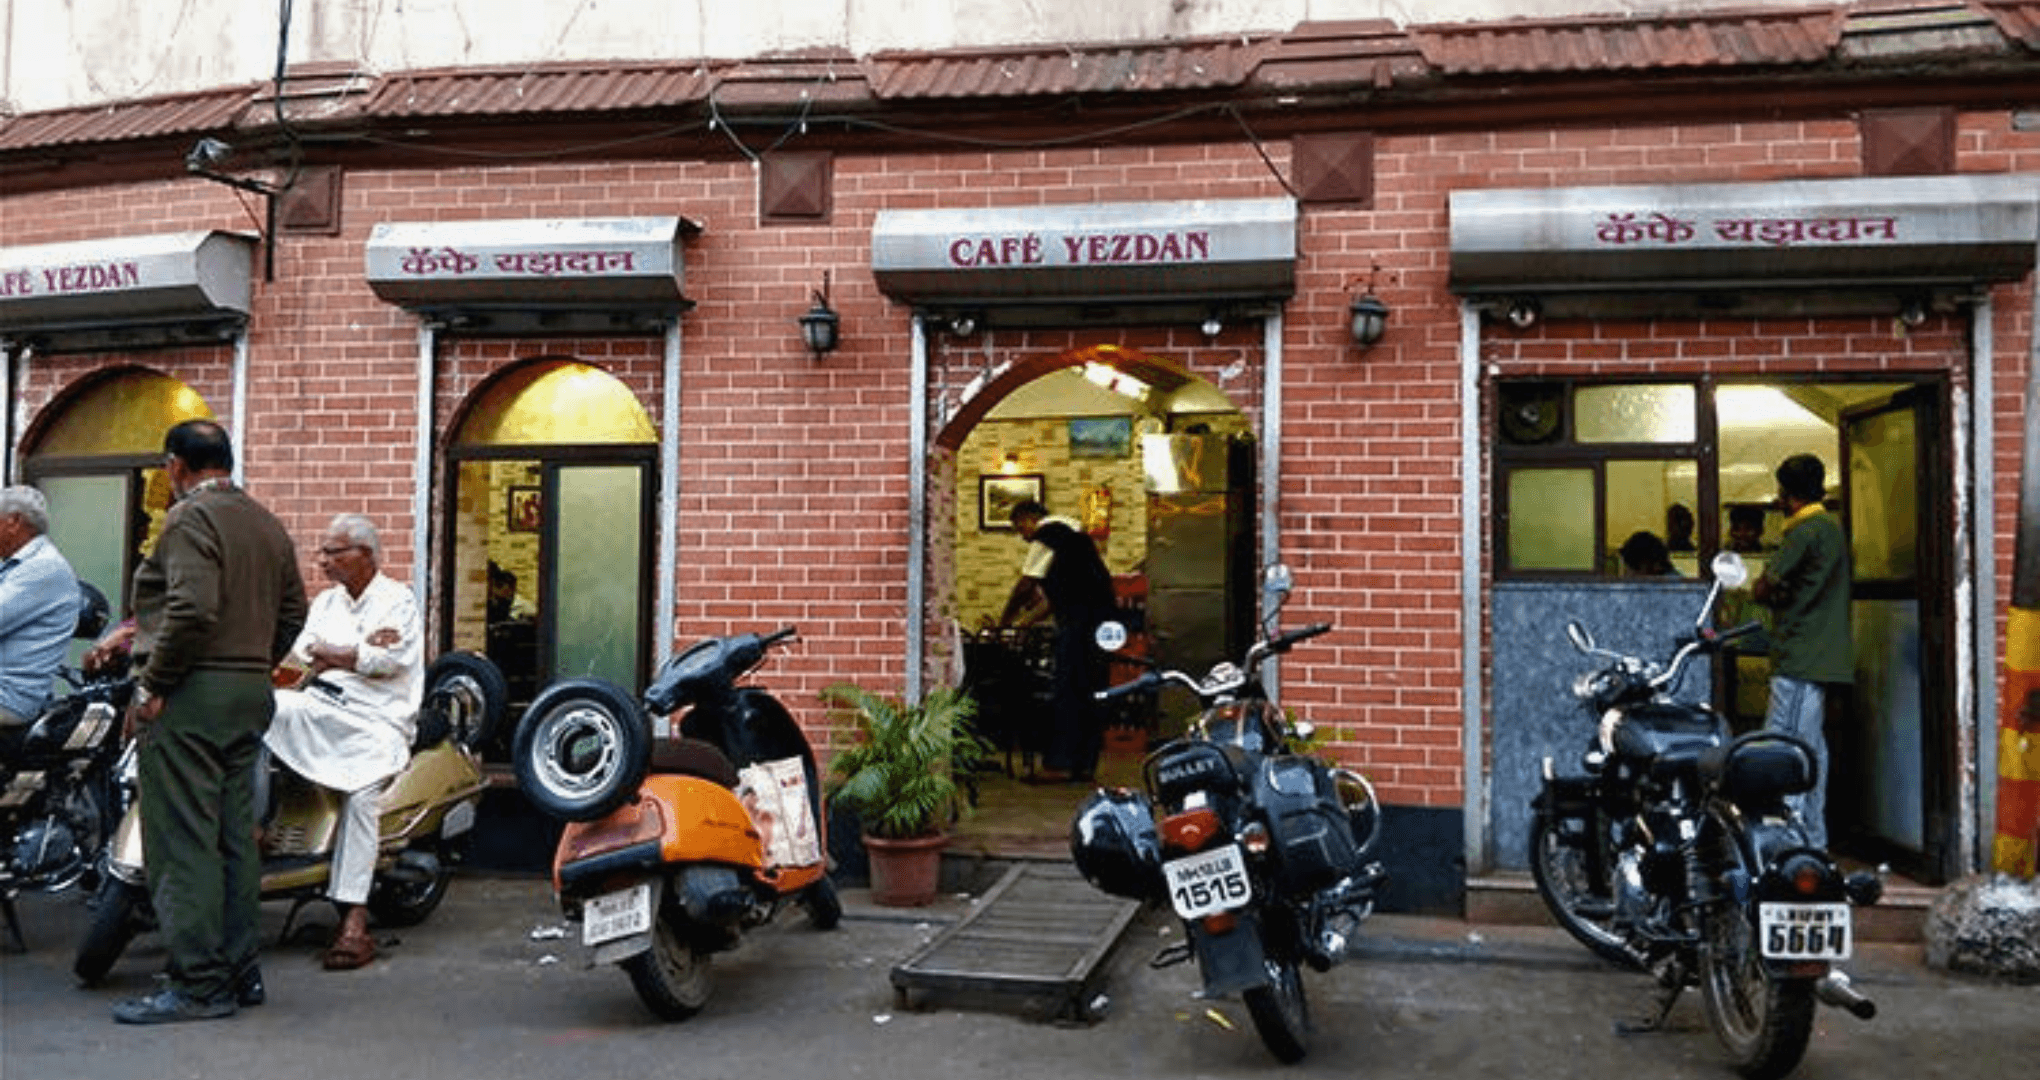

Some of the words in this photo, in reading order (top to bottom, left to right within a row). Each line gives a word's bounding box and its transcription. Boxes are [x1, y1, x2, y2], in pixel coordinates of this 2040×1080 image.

[949, 232, 1043, 267] CAFÉ
[1063, 231, 1209, 264] YEZDAN
[0, 267, 33, 295] FÉ
[43, 261, 140, 292] YEZDAN
[1176, 871, 1246, 910] 1515
